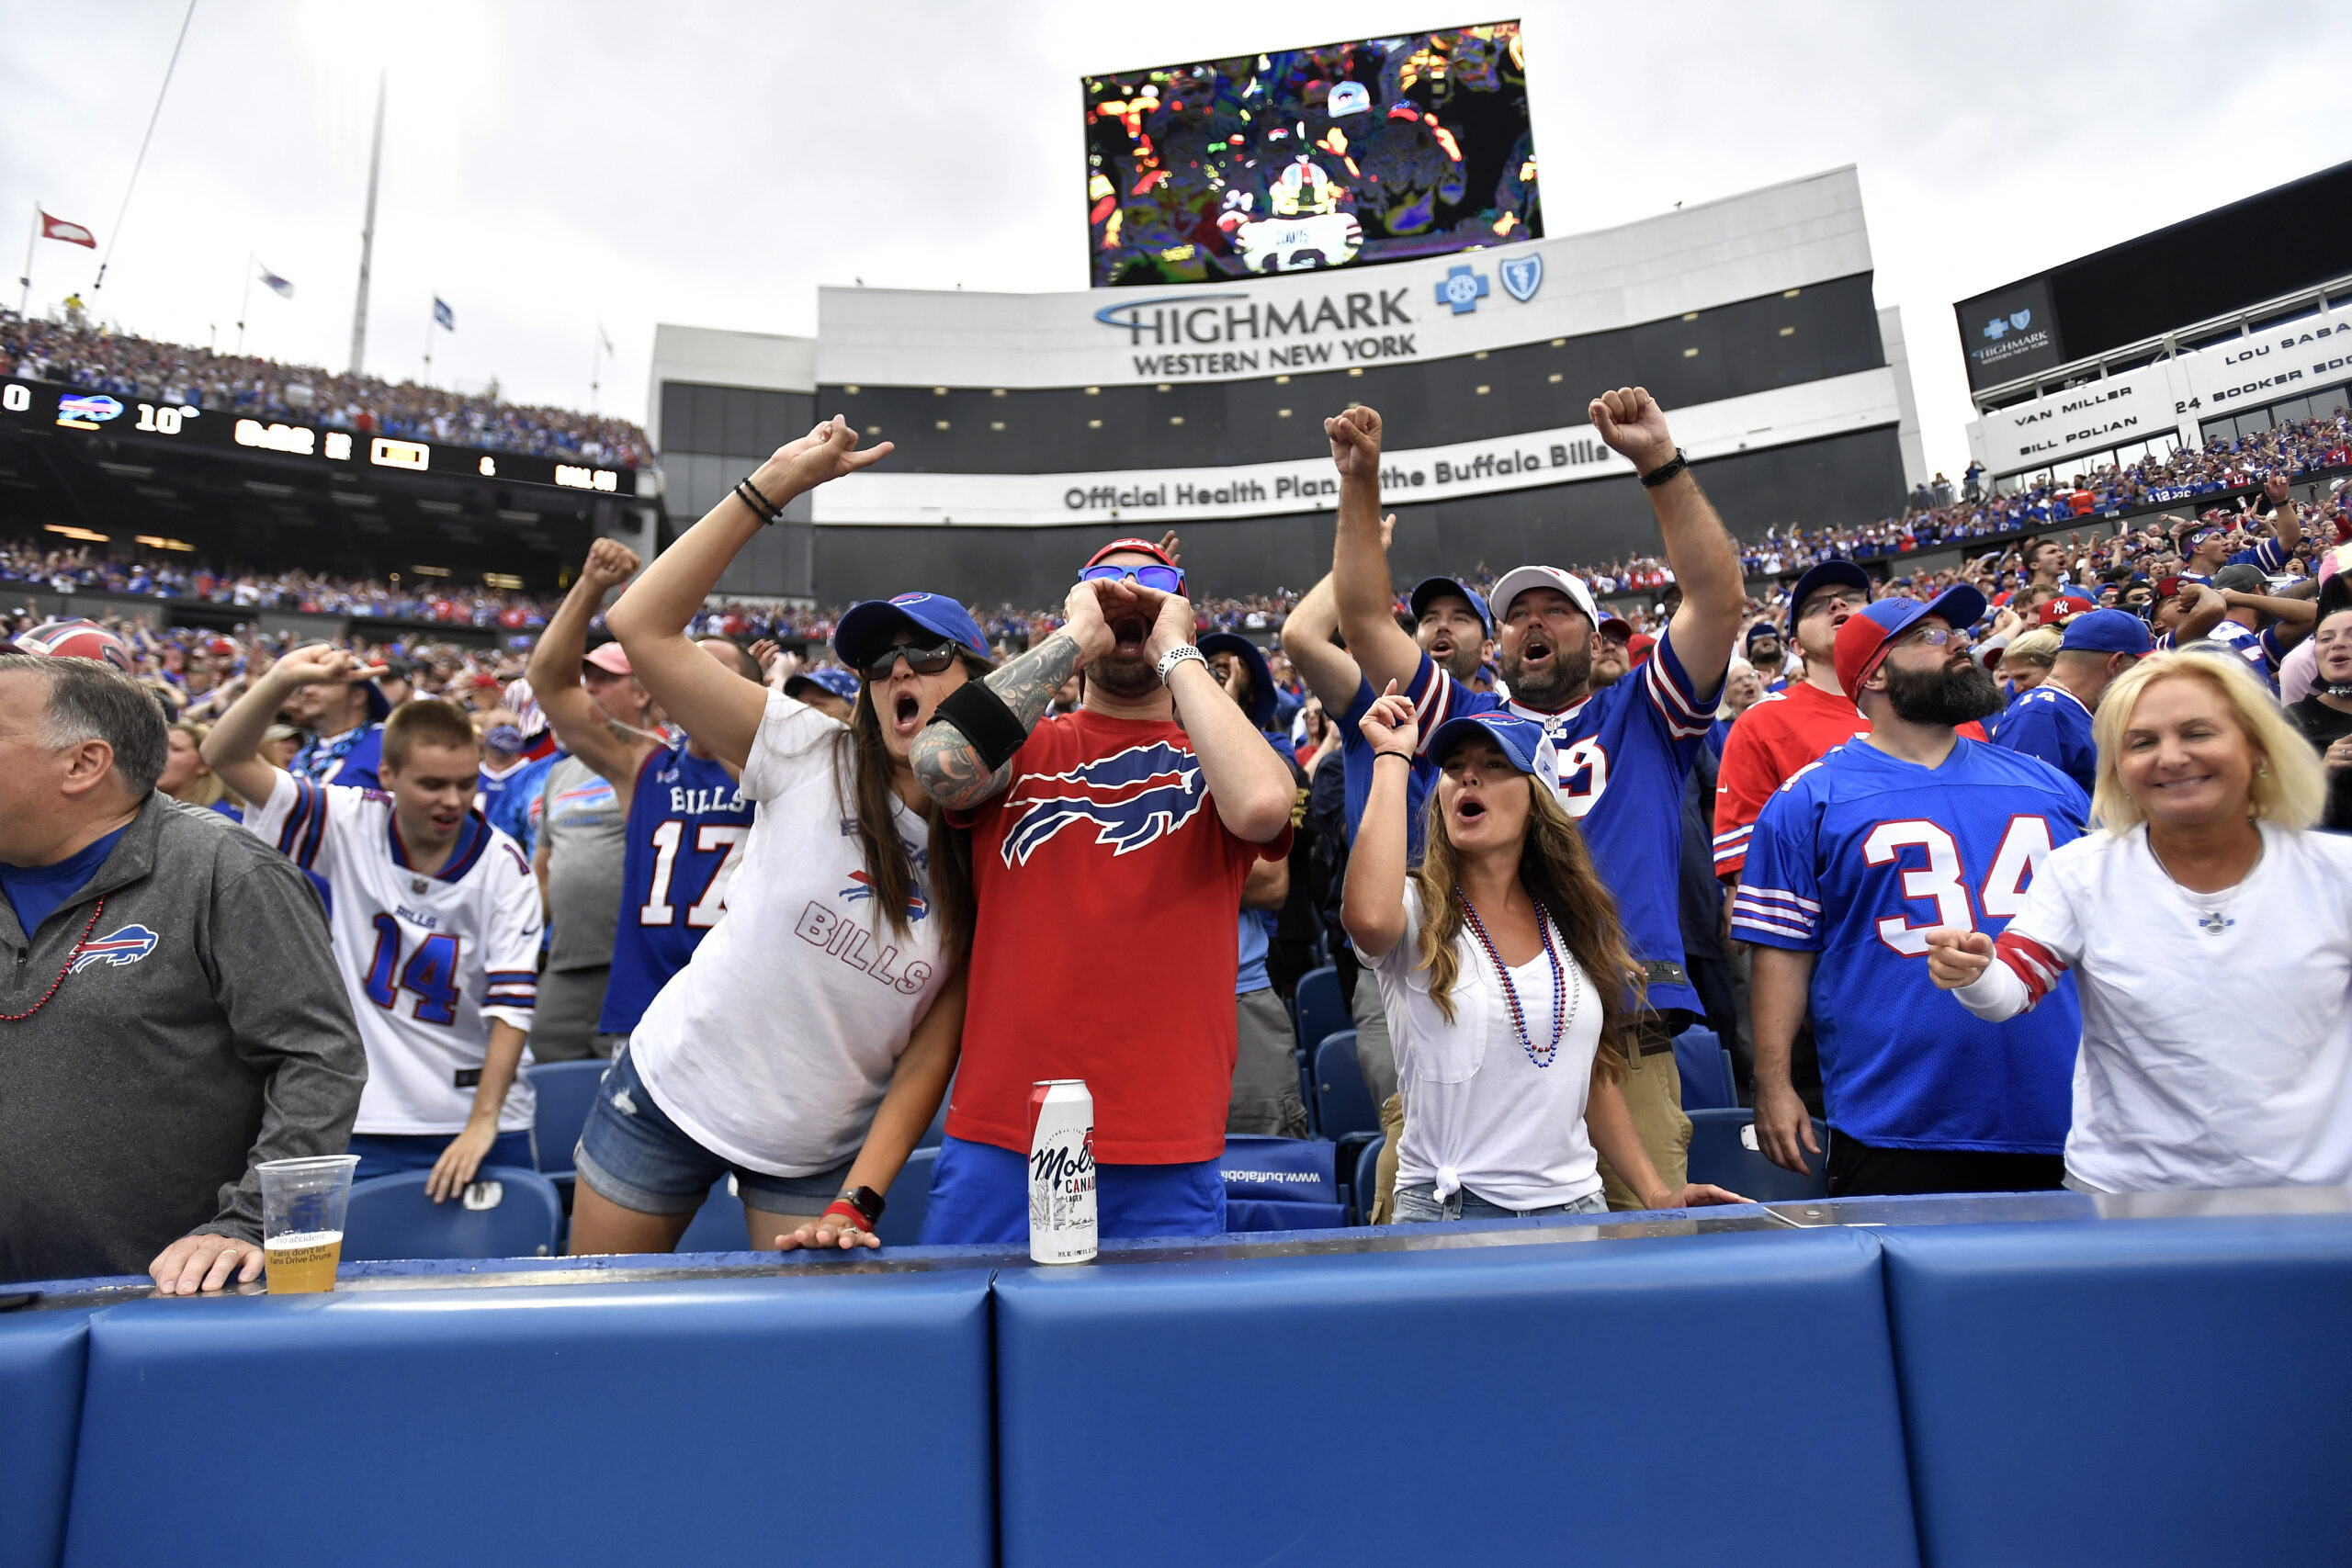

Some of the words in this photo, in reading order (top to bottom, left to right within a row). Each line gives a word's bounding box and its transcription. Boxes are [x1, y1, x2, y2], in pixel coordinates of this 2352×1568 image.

[1129, 287, 1413, 346] HIGHMARK
[1133, 349, 1259, 377] WESTERN
[1269, 341, 1334, 368] NEW
[1341, 333, 1418, 361] YORK
[1979, 330, 2048, 359] HIGHMARK
[2013, 345, 2030, 355] NEW
[2224, 344, 2271, 366] LOU
[2, 383, 31, 412] 0
[2014, 409, 2053, 426] VAN
[2062, 386, 2132, 414] MILLER
[2175, 397, 2202, 414] 24
[2212, 369, 2303, 402] BOOKER
[135, 403, 183, 434] 10
[2019, 440, 2058, 456] BILL
[2065, 416, 2138, 443] POLIAN
[1064, 483, 1167, 509] Official
[1176, 478, 1267, 505] Health
[1275, 475, 1337, 499] Plan
[1381, 465, 1426, 489] the
[1435, 448, 1542, 484] Buffalo
[1550, 438, 1610, 467] Bills
[2053, 600, 2069, 615] NY
[669, 785, 748, 815] BILLS
[639, 819, 753, 929] 17
[1860, 813, 2055, 959] 34
[794, 900, 933, 995] BILLS
[363, 911, 460, 1026] 14
[1655, 963, 1668, 973] XL
[1066, 1194, 1082, 1203] LAGER
[286, 1256, 308, 1265] Drive
